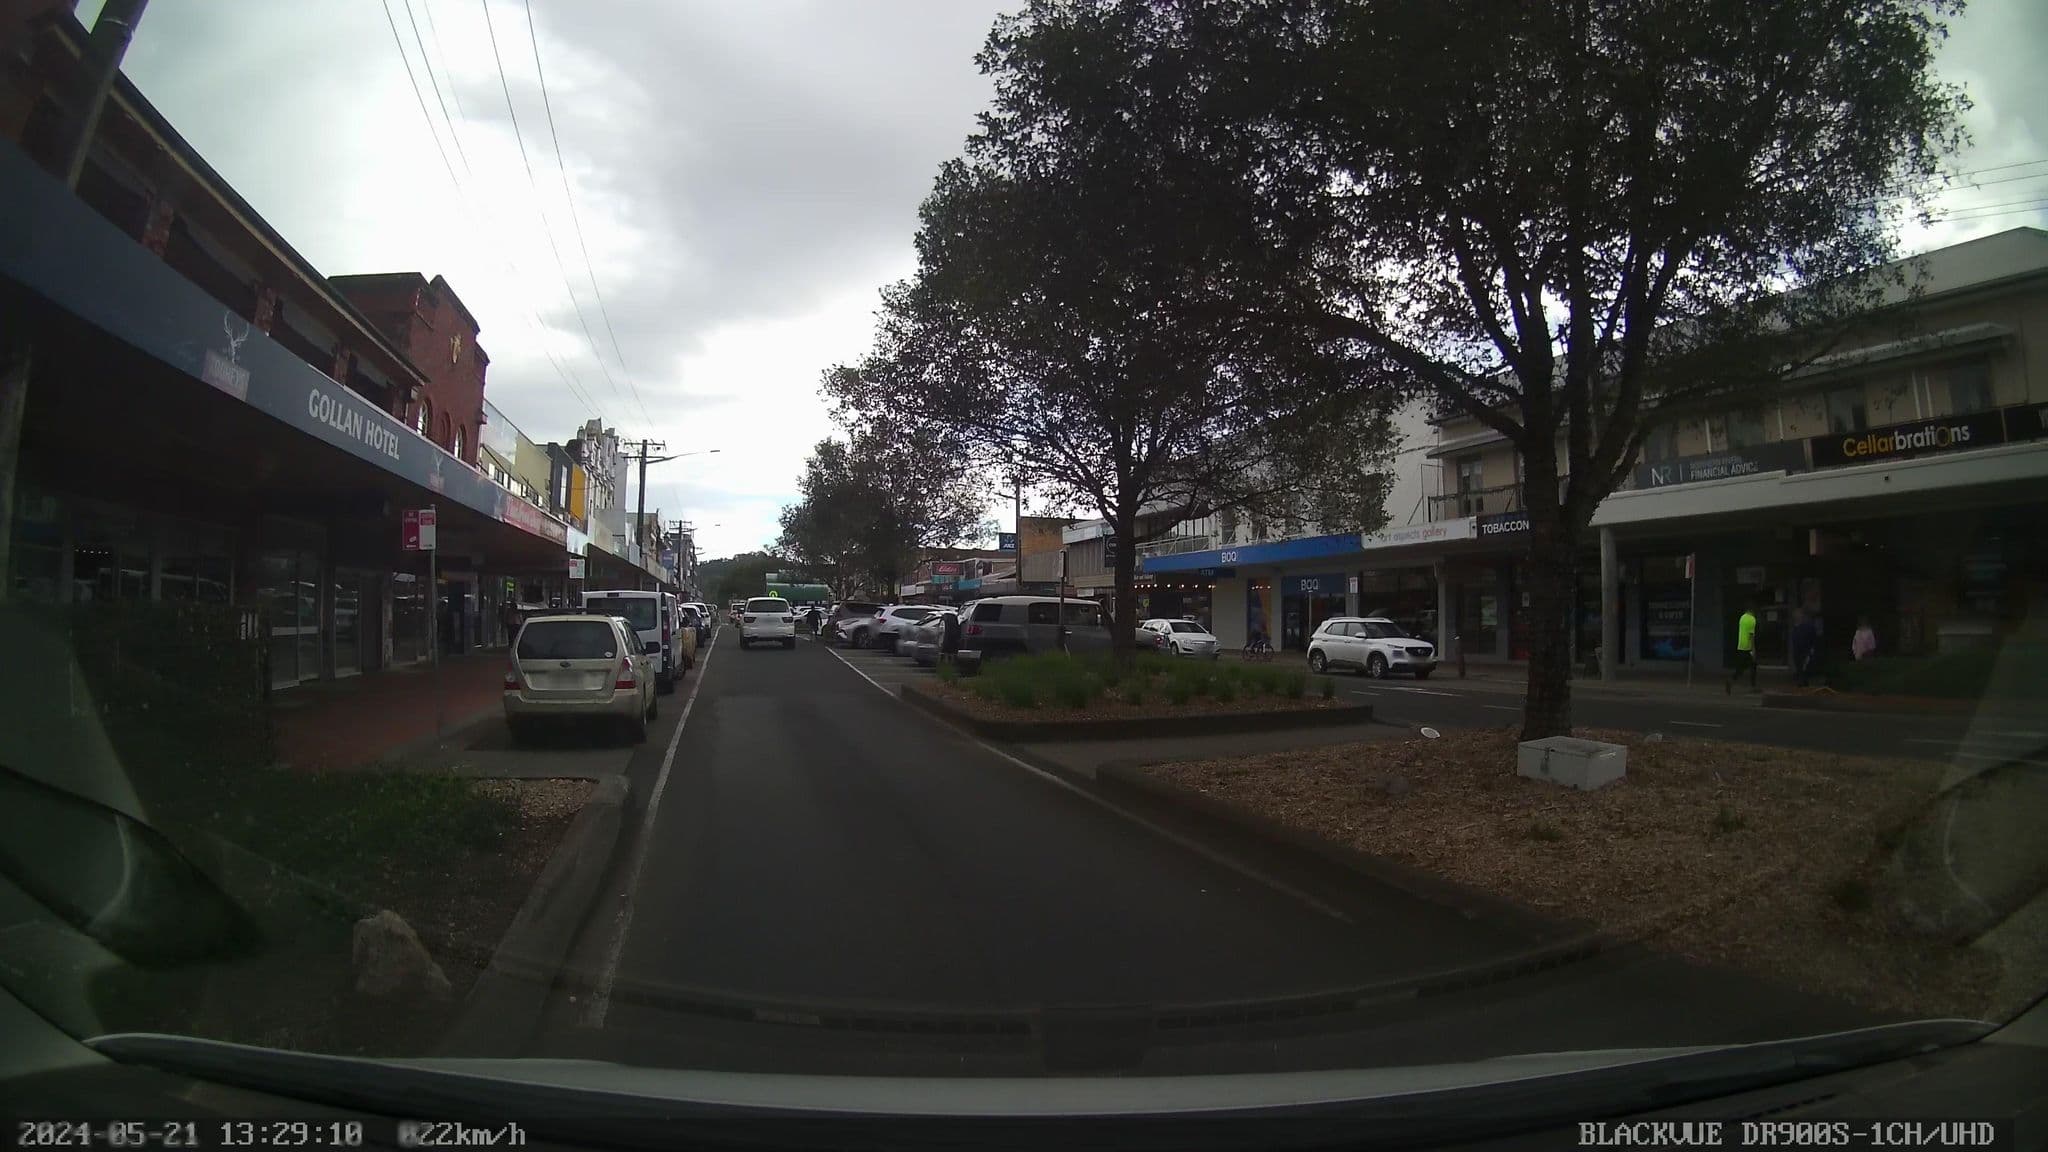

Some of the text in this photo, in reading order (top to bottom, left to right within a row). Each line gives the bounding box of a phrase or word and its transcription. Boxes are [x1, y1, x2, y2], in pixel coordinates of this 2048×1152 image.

[308, 388, 400, 460] GOLLAN HOTEL
[1842, 424, 1970, 457] Cellarbrations
[1422, 526, 1448, 540] gallery
[1221, 551, 1237, 563] BOQ
[1300, 578, 1319, 591] BOQ
